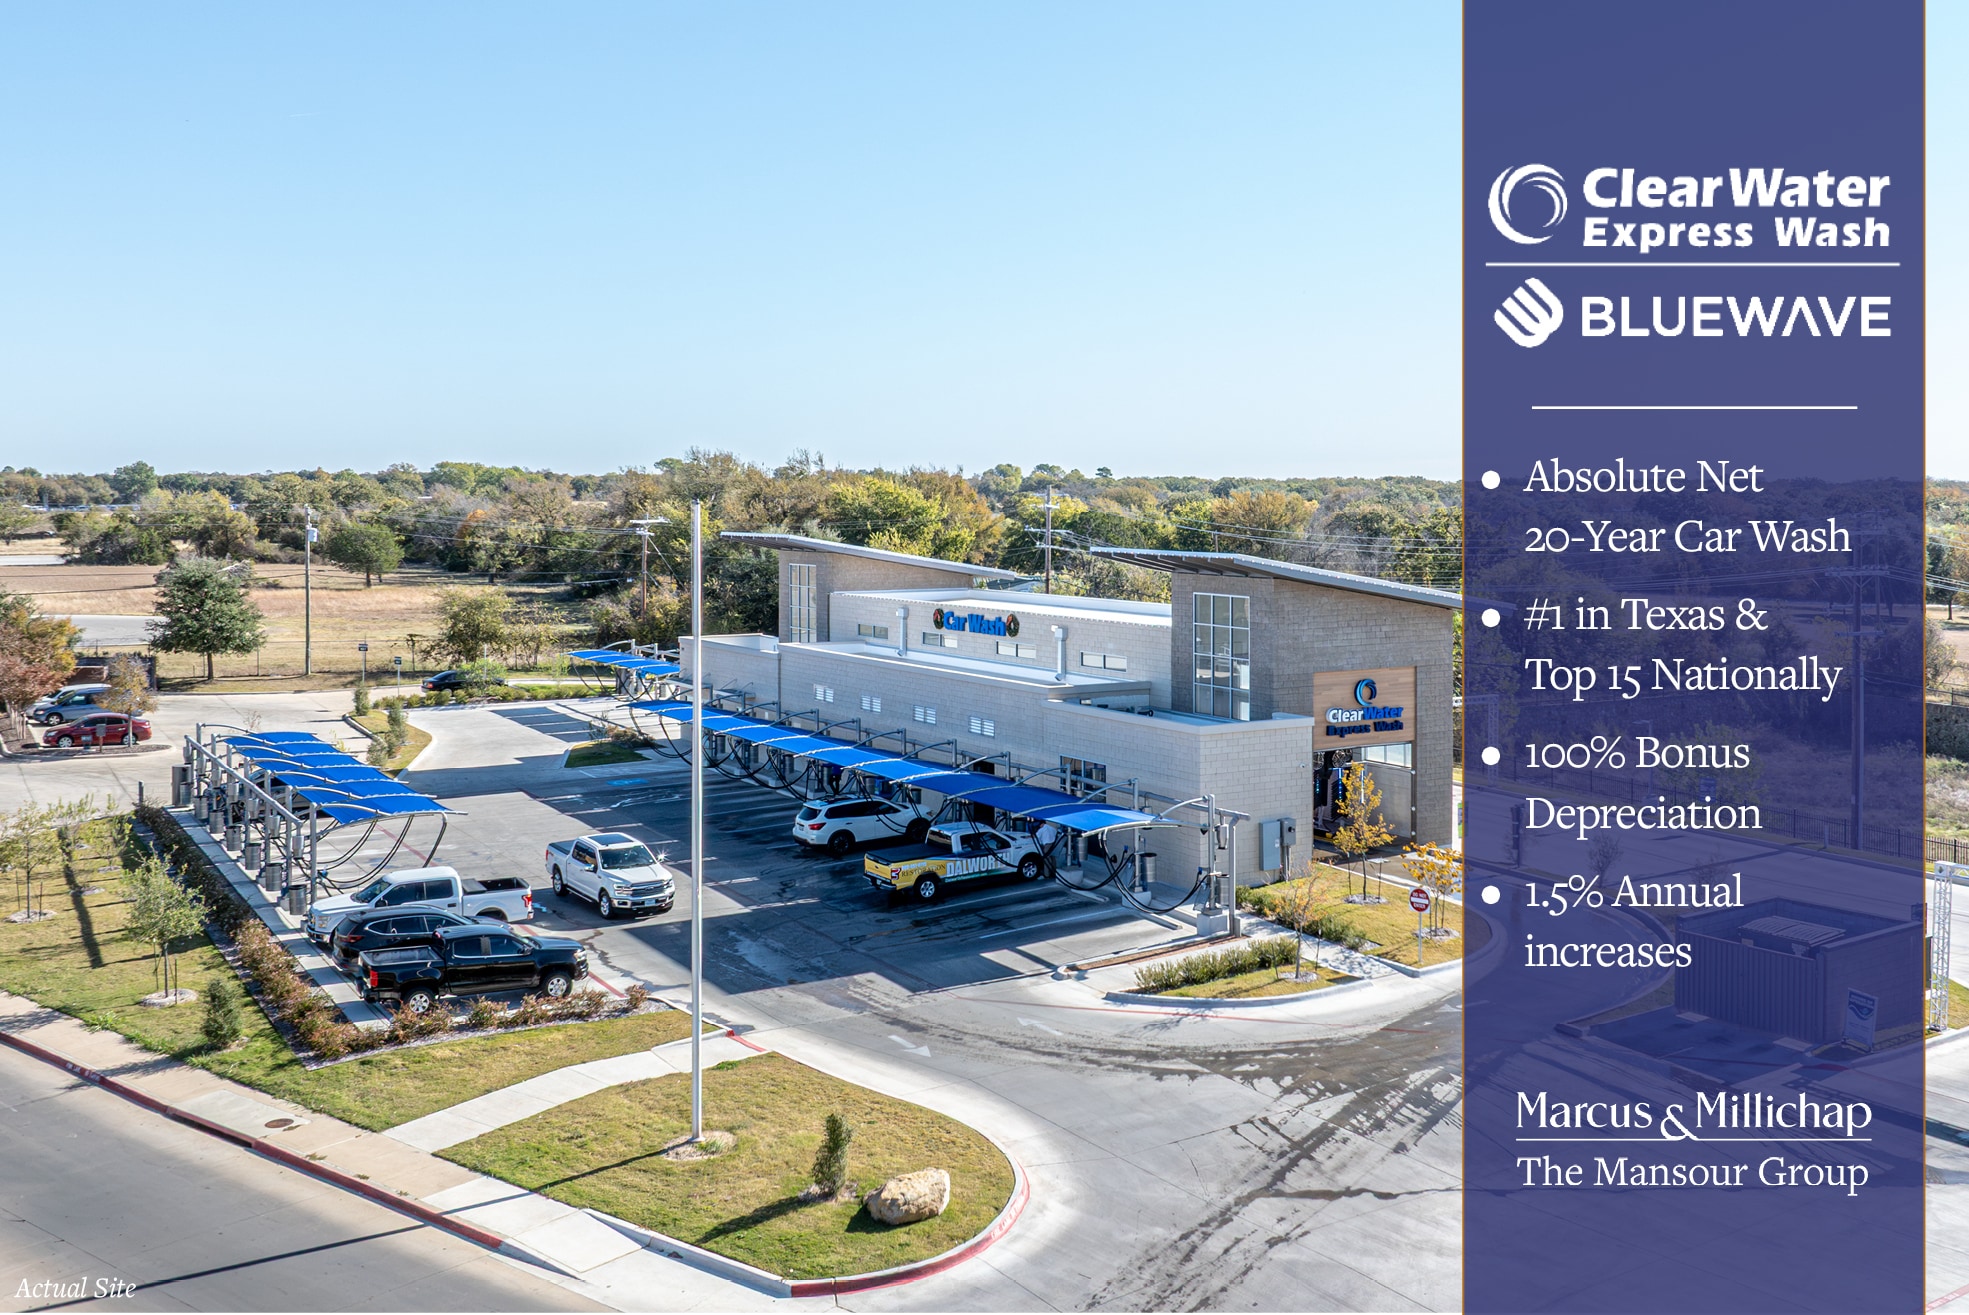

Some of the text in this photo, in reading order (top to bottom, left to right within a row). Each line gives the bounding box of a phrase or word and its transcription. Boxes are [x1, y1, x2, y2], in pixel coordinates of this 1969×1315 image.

[944, 611, 1006, 636] Car Wash
[1326, 706, 1404, 723] ClearWater
[1326, 720, 1404, 738] Express Wash
